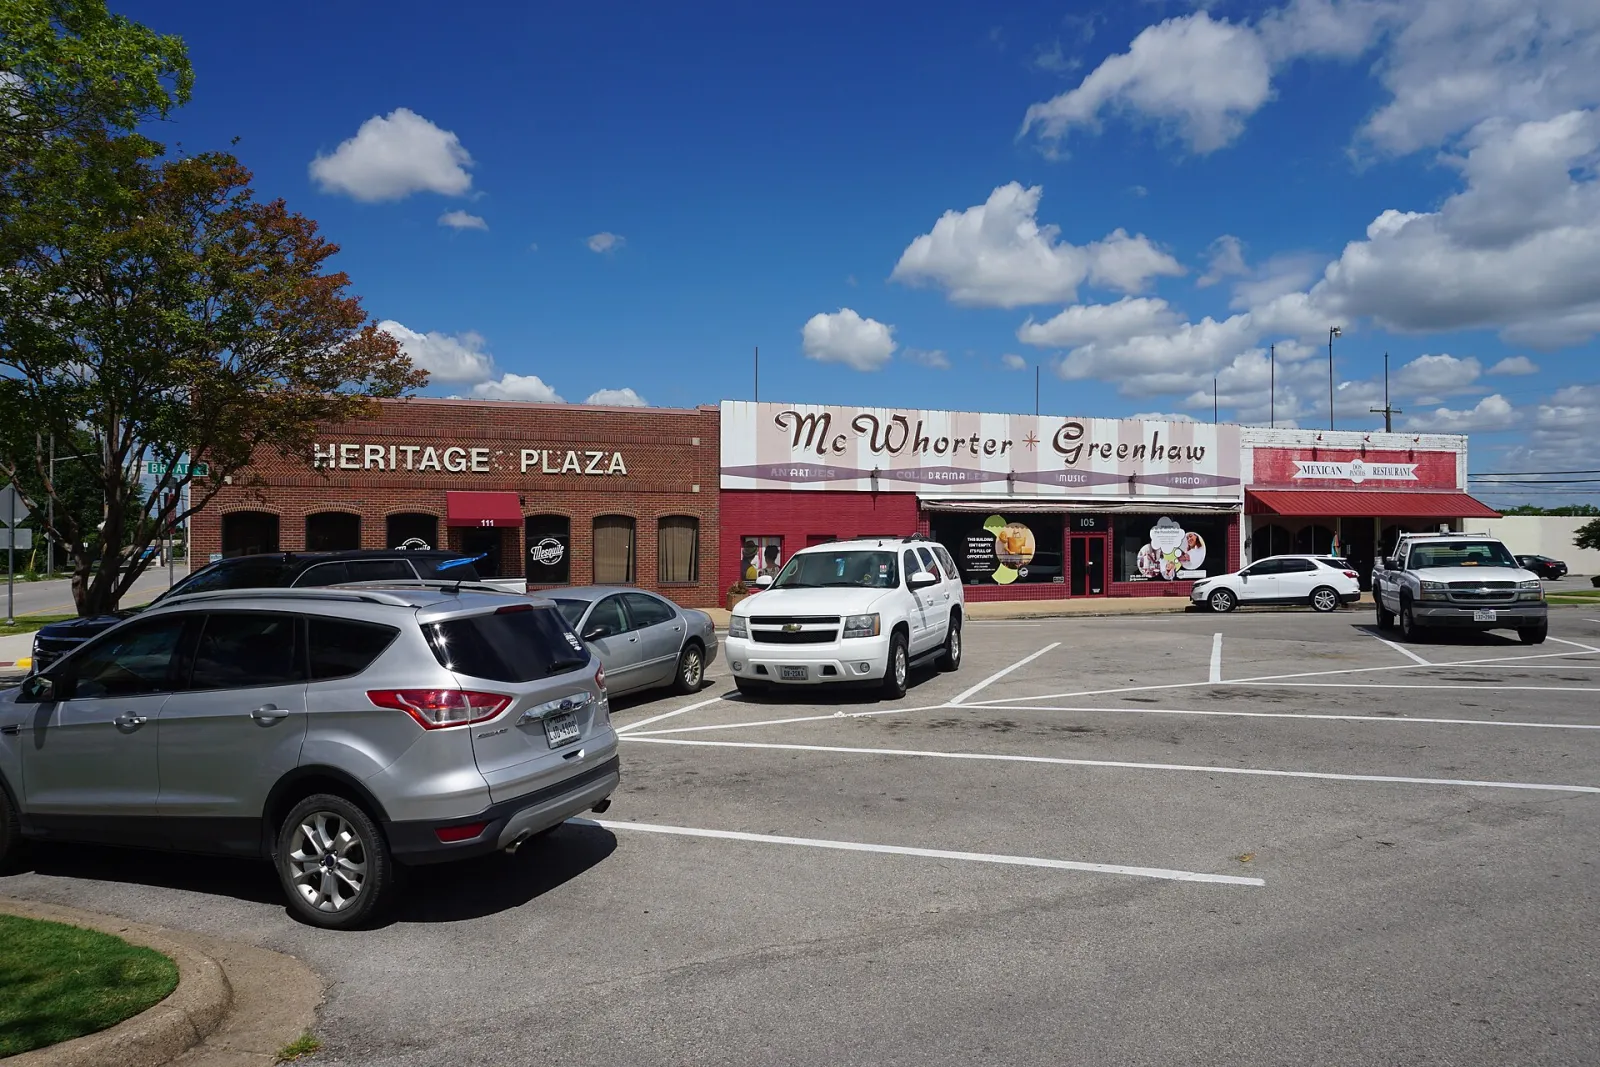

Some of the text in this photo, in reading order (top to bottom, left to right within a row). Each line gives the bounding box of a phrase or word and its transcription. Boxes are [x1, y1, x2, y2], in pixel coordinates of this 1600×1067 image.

[774, 410, 1205, 465] Mc Whorter Greenhaw
[314, 443, 627, 475] HERITAGE PLAZA
[151, 463, 190, 474] BRAD
[790, 468, 809, 477] ART
[1302, 465, 1342, 475] MEXICAN
[1372, 466, 1410, 477] RESTAURANT
[928, 471, 966, 480] DRAMA
[1059, 474, 1087, 483] MUSIC
[1174, 476, 1200, 485] PIANO
[481, 519, 494, 527] 111
[1080, 518, 1095, 527] 105
